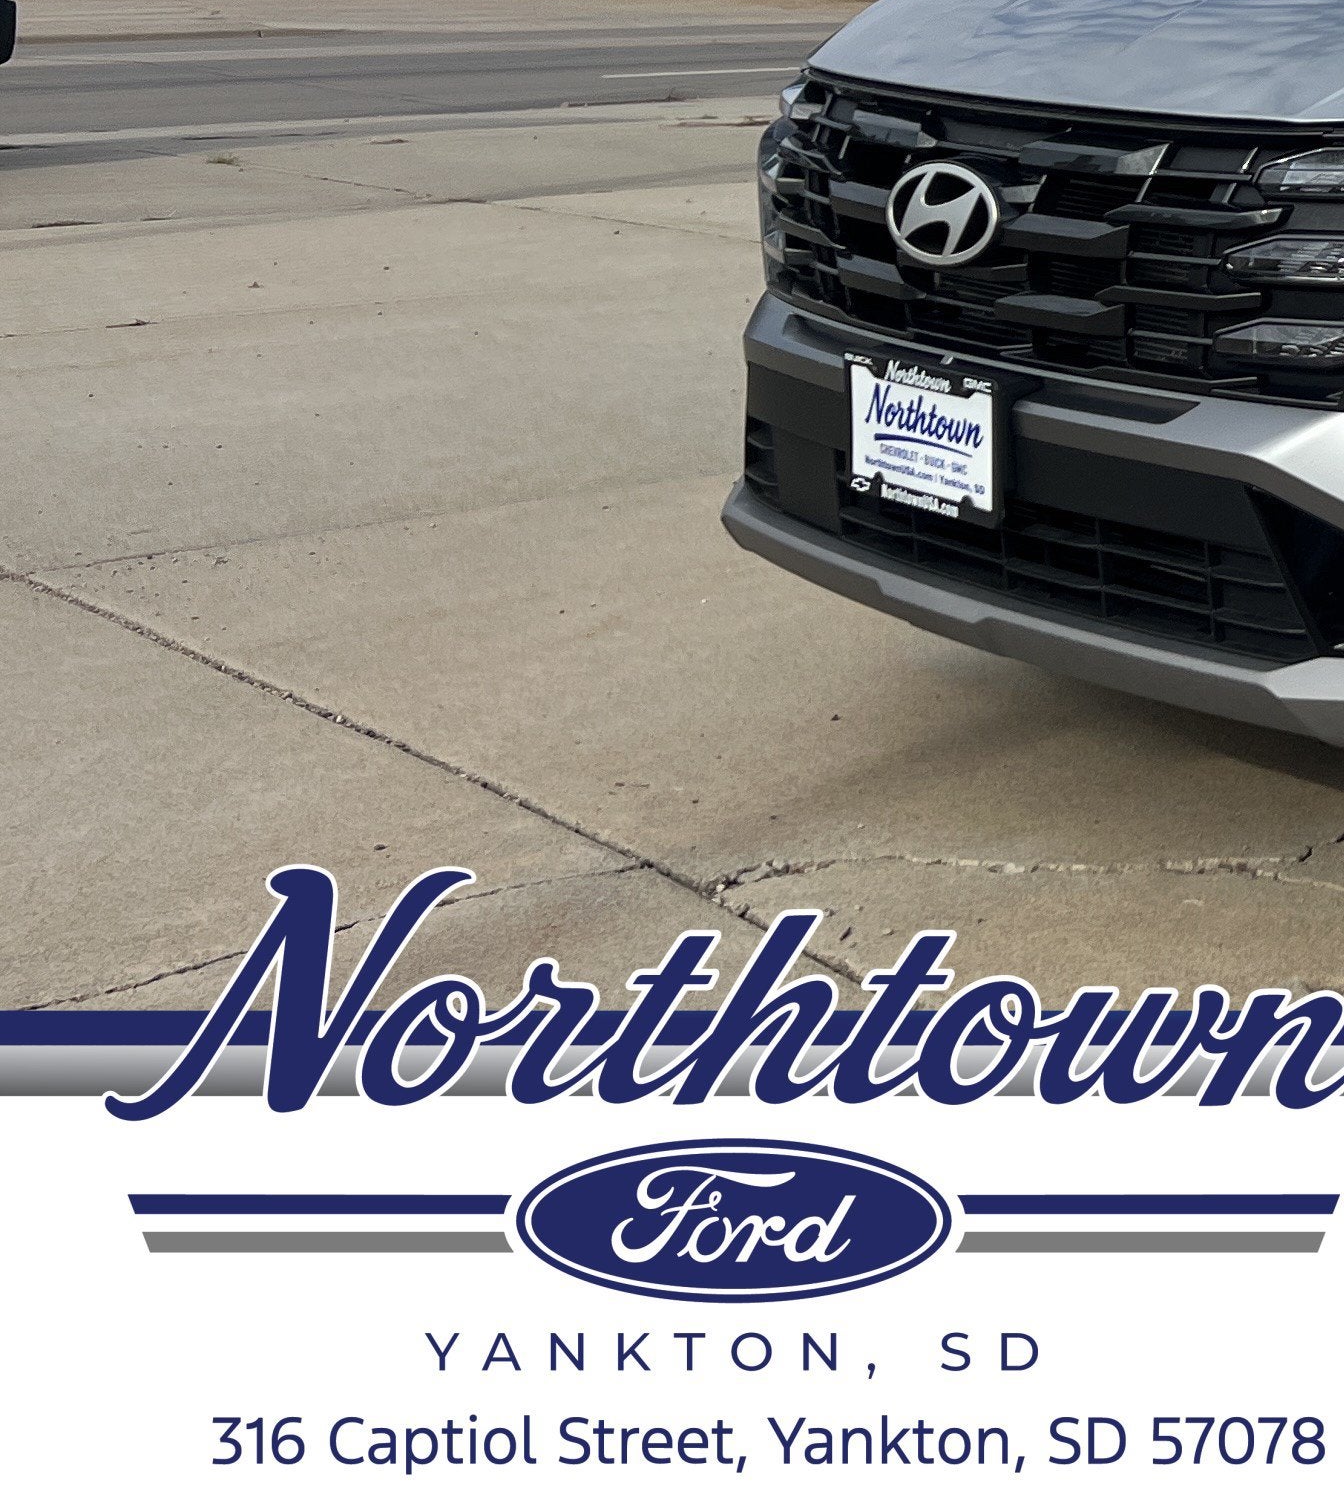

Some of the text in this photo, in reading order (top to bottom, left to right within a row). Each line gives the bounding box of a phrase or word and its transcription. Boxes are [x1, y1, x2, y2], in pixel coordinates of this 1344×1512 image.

[884, 359, 952, 393] Northtown
[963, 377, 992, 393] GMC
[865, 383, 984, 449] Northtown
[880, 443, 919, 463] CHEVROLET
[865, 455, 934, 483] NorthtownUSA.com
